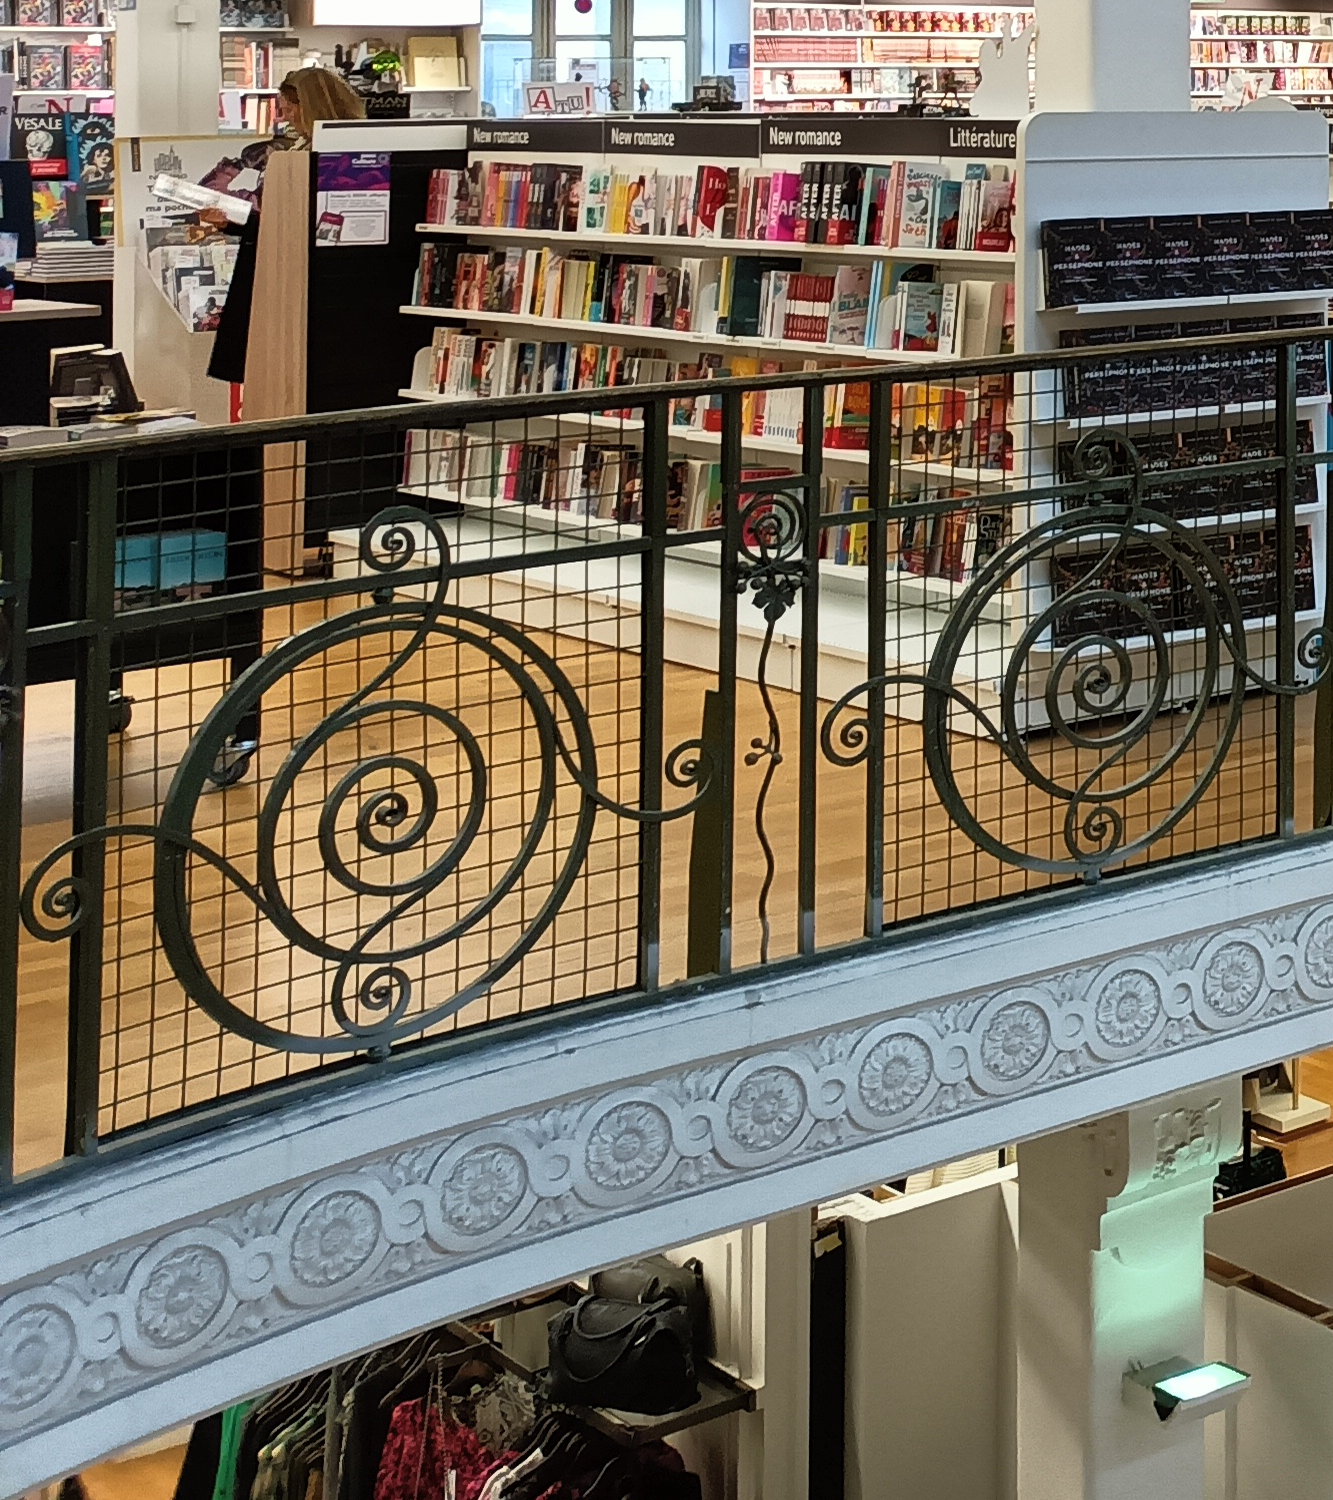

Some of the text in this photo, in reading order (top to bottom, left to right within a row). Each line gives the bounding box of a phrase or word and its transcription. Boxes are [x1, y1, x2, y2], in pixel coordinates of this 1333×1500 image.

[473, 127, 530, 145] New romance
[611, 127, 675, 147] New romance
[769, 126, 842, 146] New romance
[949, 126, 1017, 148] Littérature
[800, 183, 811, 220] AFTER
[809, 183, 819, 220] AFTER
[821, 183, 832, 220] AFTER
[831, 184, 842, 220] AFTER
